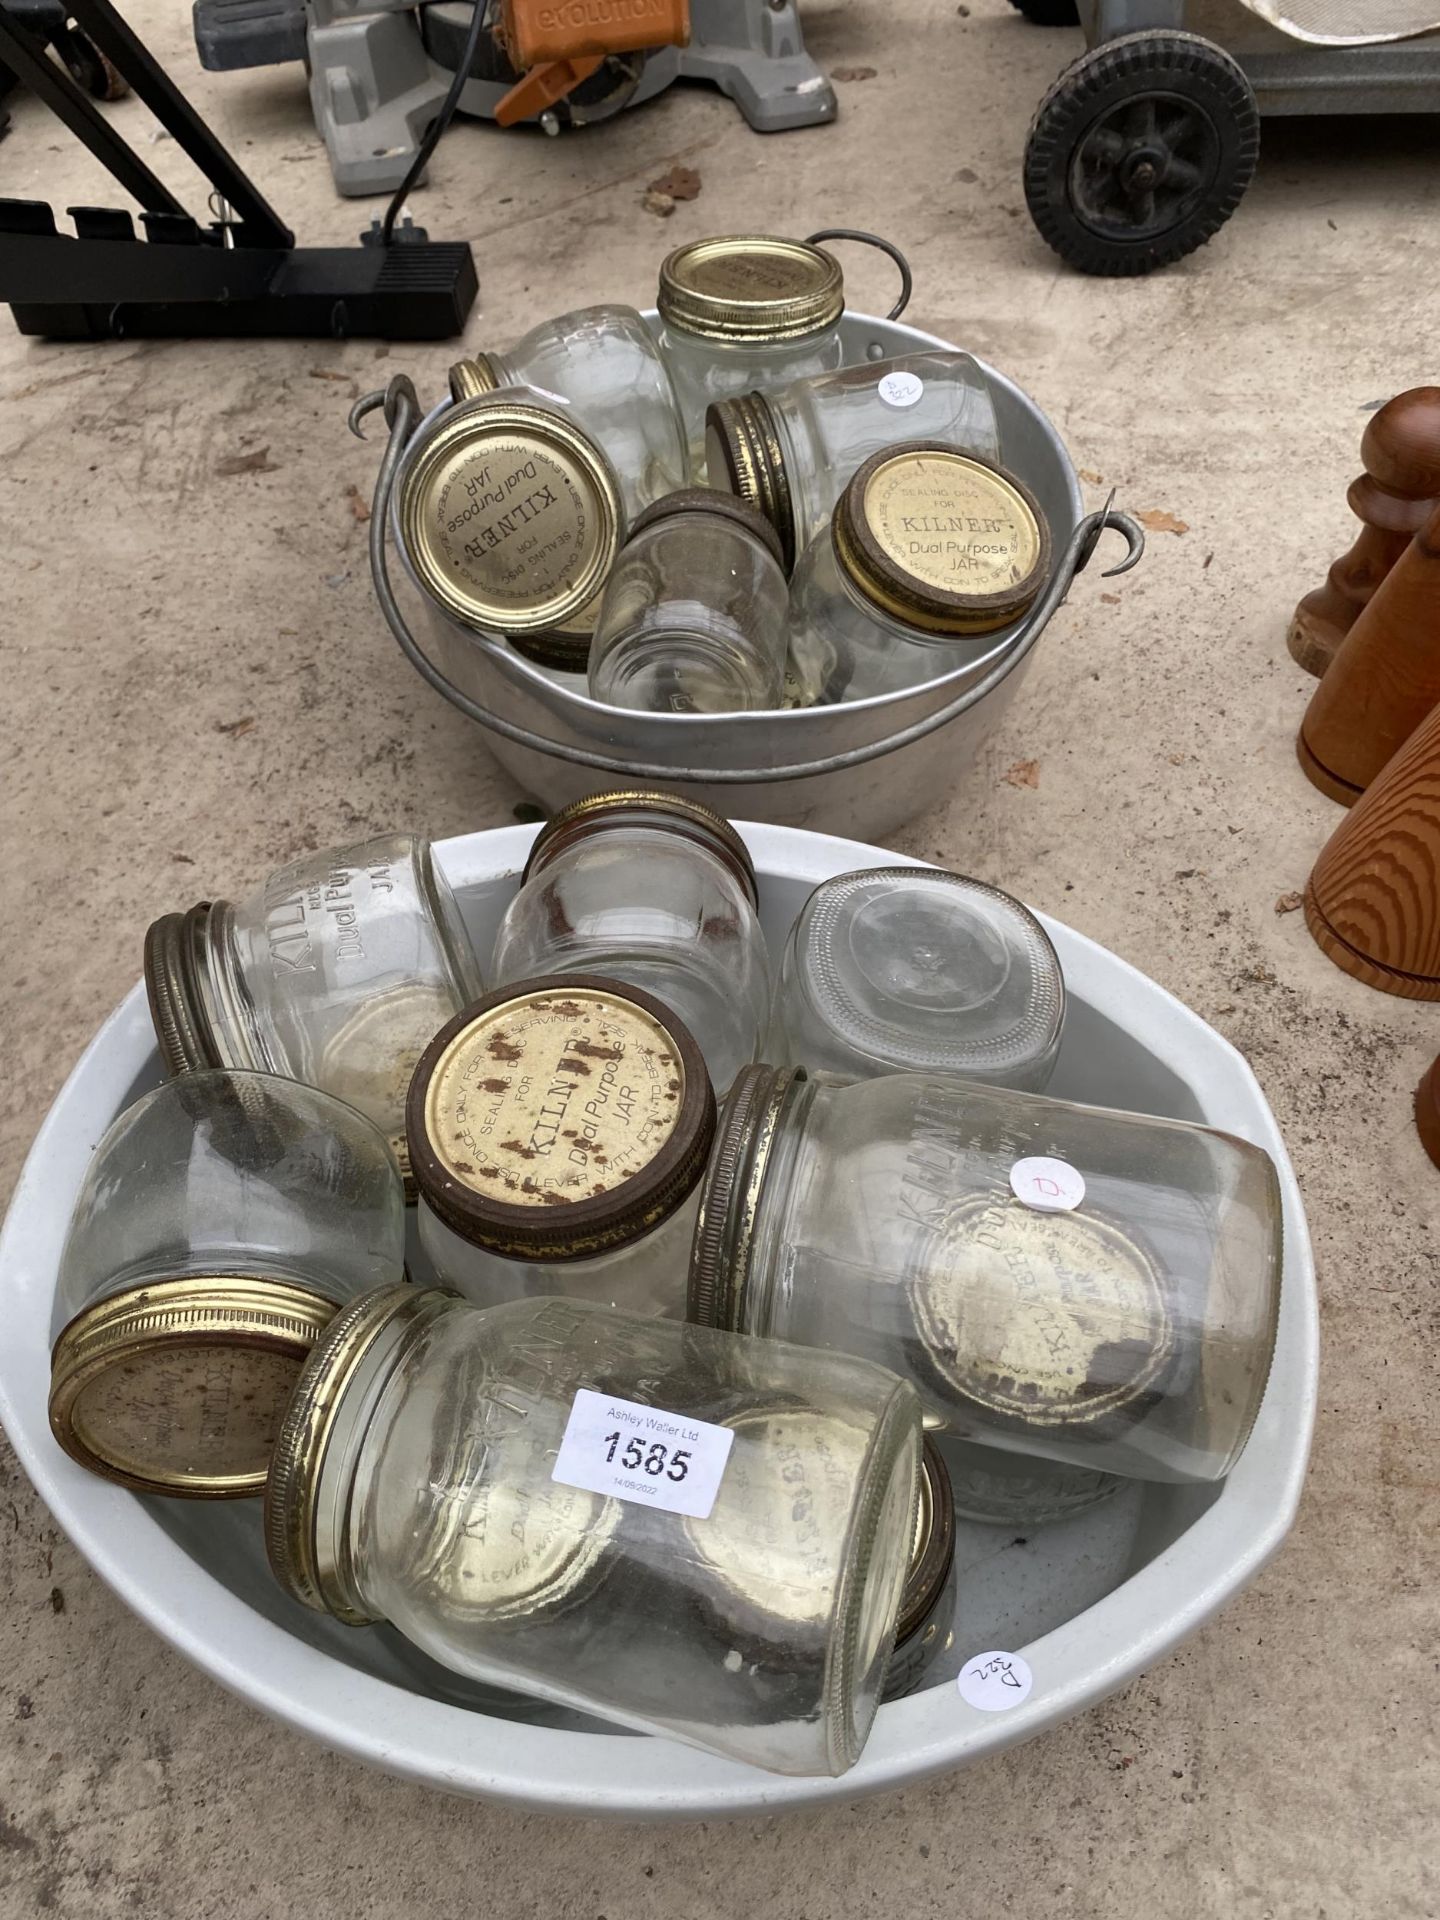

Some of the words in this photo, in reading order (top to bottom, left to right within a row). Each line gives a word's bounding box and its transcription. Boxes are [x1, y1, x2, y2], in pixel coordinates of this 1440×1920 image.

[494, 446, 528, 456] WITH
[532, 452, 567, 480] LEVER
[463, 466, 491, 497] JAR
[503, 461, 537, 498] Dual
[902, 488, 949, 499] SEALING
[954, 489, 979, 499] DISC
[437, 485, 451, 523] BREAK
[448, 486, 505, 533] Purpose
[934, 499, 955, 509] FOR
[463, 485, 558, 561] KILNER
[901, 516, 1001, 533] KILNER
[519, 535, 538, 555] FOR
[528, 530, 572, 567] SEALING
[910, 541, 942, 554] Dual
[946, 541, 1008, 558] Purpose
[501, 564, 526, 585] DISC
[949, 557, 979, 571] JAR
[367, 856, 393, 893] JAR
[325, 903, 367, 960] Dual
[486, 1015, 578, 1050] ESERVING
[595, 1018, 628, 1038] SEAL
[465, 1055, 486, 1082] FOR
[507, 1039, 527, 1068] DSC
[630, 1039, 659, 1079] BREAK
[515, 1075, 534, 1102] FOR
[528, 1036, 585, 1156] KILNR
[650, 1084, 662, 1103] TO
[455, 1086, 468, 1124] ONLY
[612, 1085, 640, 1126] JAR
[636, 1109, 660, 1142] COIN
[460, 1128, 490, 1164] ONCE
[568, 1117, 599, 1167] Dual
[596, 1145, 637, 1176] WITH
[534, 1172, 589, 1188] LEVER
[607, 1407, 643, 1427] Ashley
[646, 1418, 680, 1436] Waller
[681, 1428, 700, 1441] Ltd
[604, 1431, 692, 1482] 1585
